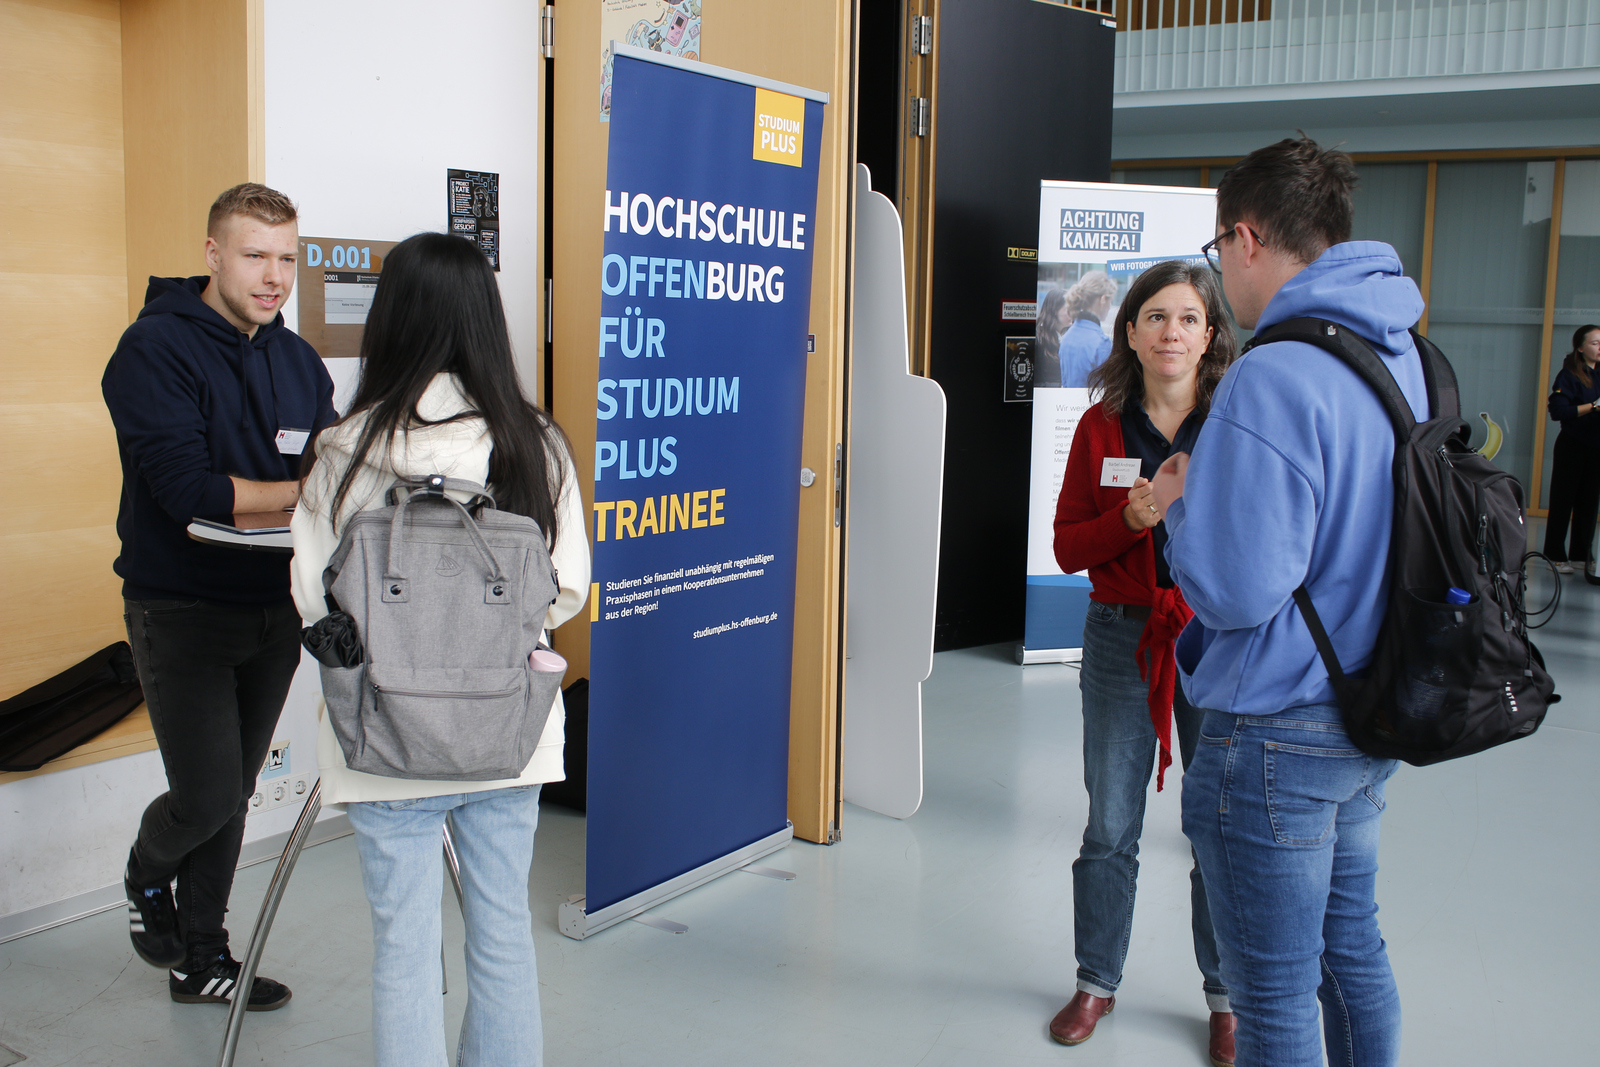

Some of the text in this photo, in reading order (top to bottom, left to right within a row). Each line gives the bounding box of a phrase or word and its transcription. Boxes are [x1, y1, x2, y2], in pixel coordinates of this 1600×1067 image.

[758, 114, 800, 134] STUDIUM
[761, 130, 796, 154] PLUS
[604, 190, 806, 250] HOCHSCHULE
[1062, 210, 1140, 230] ACHTUNG
[307, 244, 371, 268] D.001
[1062, 231, 1136, 250] KAMERA!
[601, 253, 785, 303] OFFENBURG
[1110, 263, 1125, 271] WIR
[598, 306, 666, 358] FÜR
[596, 377, 740, 421] STUDIUM
[594, 436, 678, 481] PLUS
[593, 488, 726, 542] TRAINEE
[606, 554, 774, 591] Studieren Sie finanziell unabhängig mit regelmäßigen
[606, 568, 764, 606] Praxisphasen in einem Kooperationsunternehmen
[605, 601, 659, 620] aus der Region!
[693, 612, 778, 639] studiumplus.hs-offenburg.de
